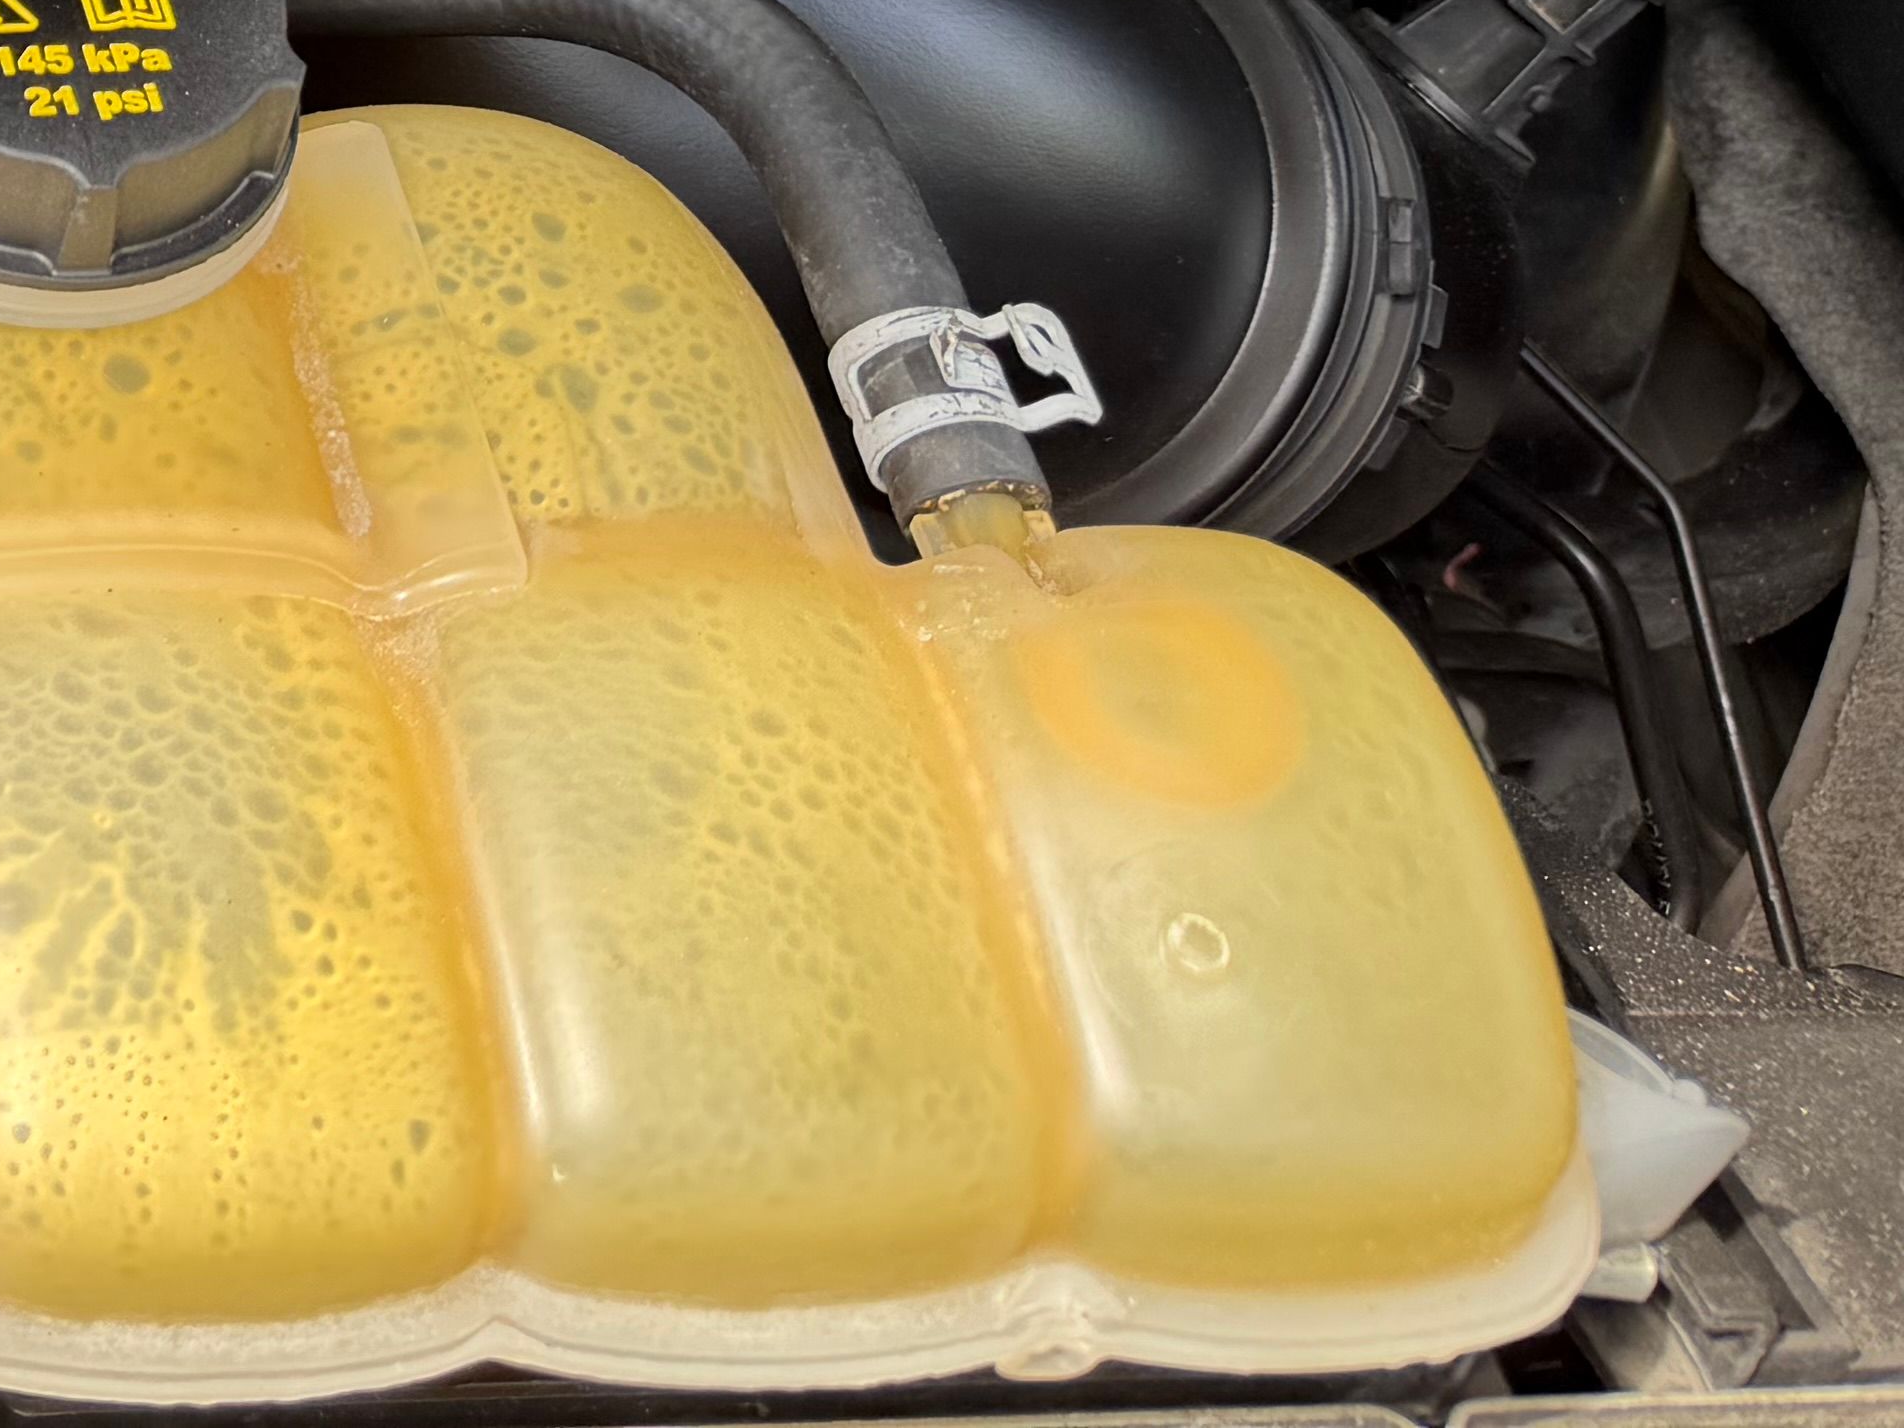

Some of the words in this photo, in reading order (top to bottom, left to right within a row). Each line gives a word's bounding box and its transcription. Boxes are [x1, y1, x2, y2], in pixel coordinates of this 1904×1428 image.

[82, 42, 173, 73] kPa
[24, 85, 80, 117] 21
[93, 82, 164, 121] psi
